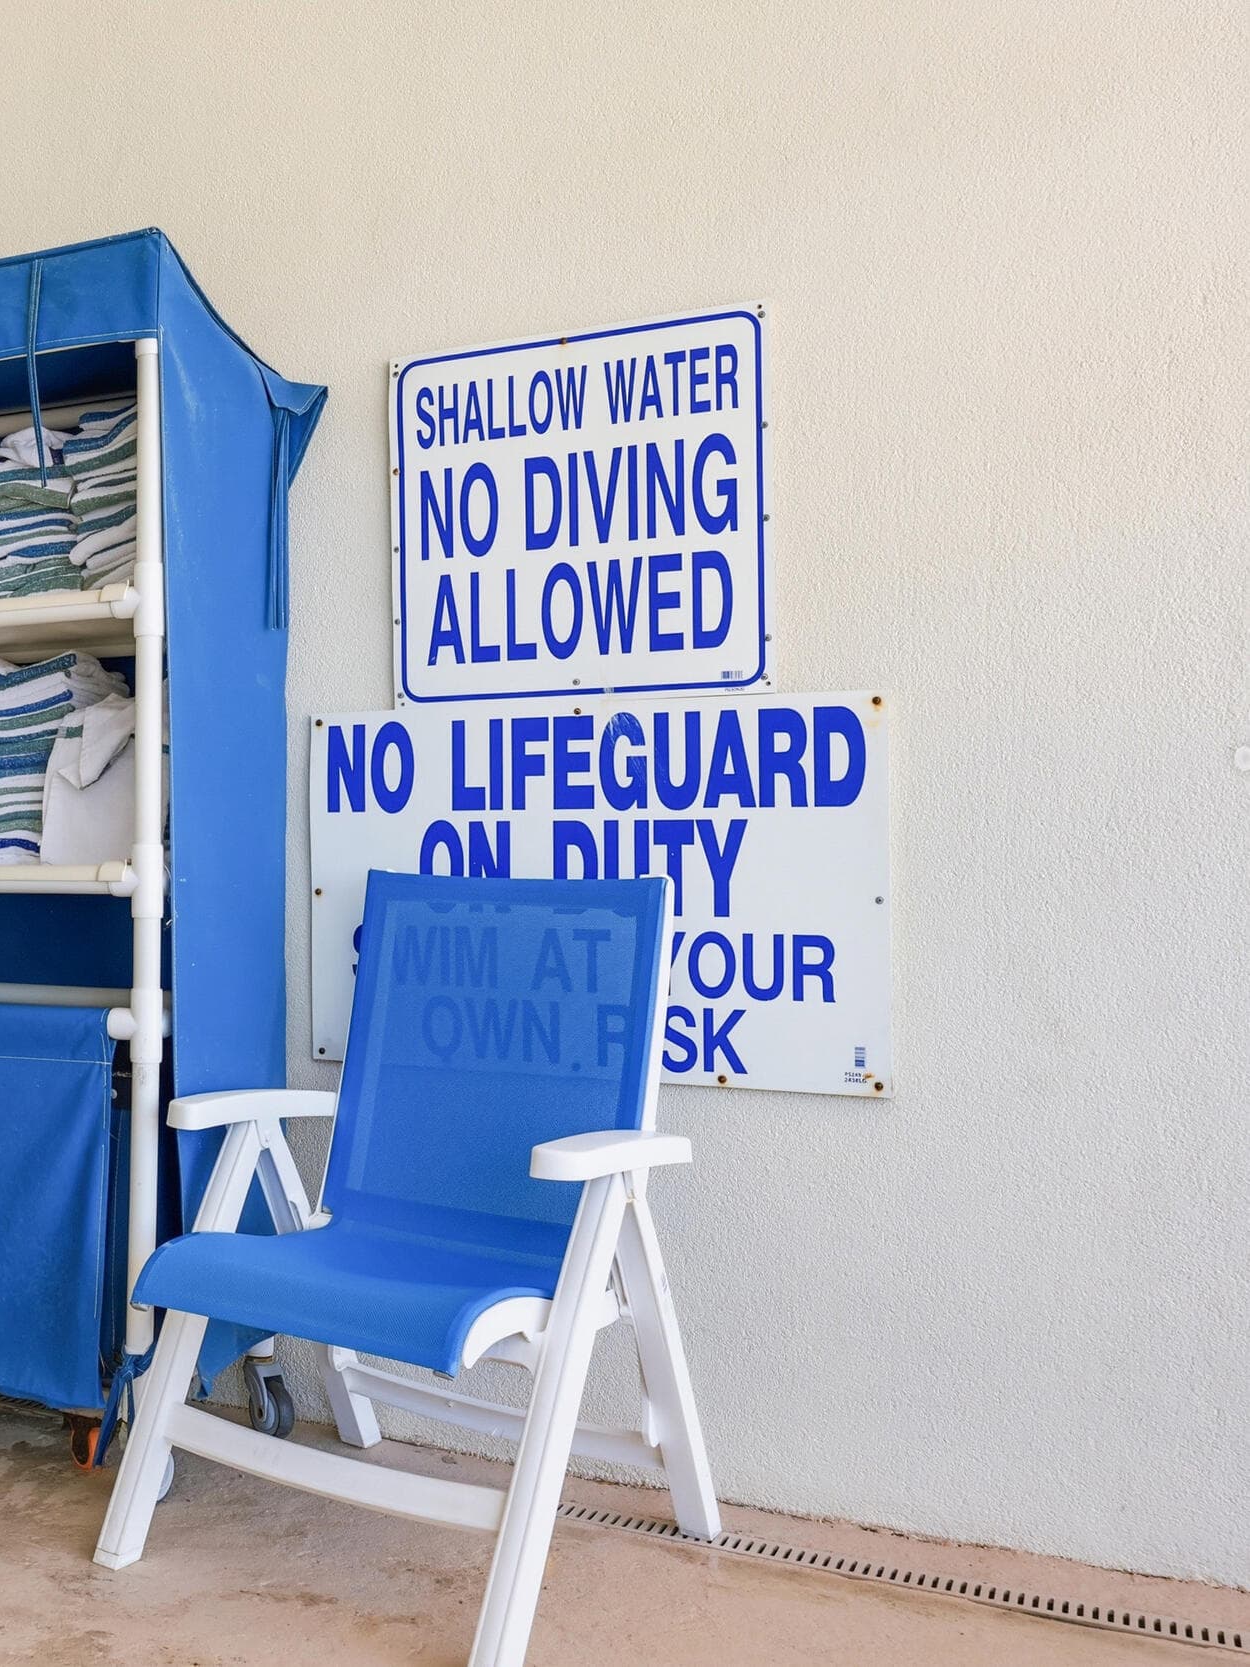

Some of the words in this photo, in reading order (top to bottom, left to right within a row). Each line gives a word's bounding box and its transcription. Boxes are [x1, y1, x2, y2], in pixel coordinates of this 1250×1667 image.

[416, 366, 587, 450] SHALLOW
[604, 344, 739, 425] WATER
[420, 462, 499, 561] NO
[524, 433, 738, 551] DIVING
[428, 550, 734, 667] ALLOWED
[326, 720, 415, 815] NO
[451, 706, 867, 813] LIFEGUARD
[419, 819, 511, 913] ON
[553, 818, 748, 918] DUTY
[530, 928, 612, 993] AT
[421, 995, 561, 1065] OWN
[597, 1003, 748, 1076] RSK
